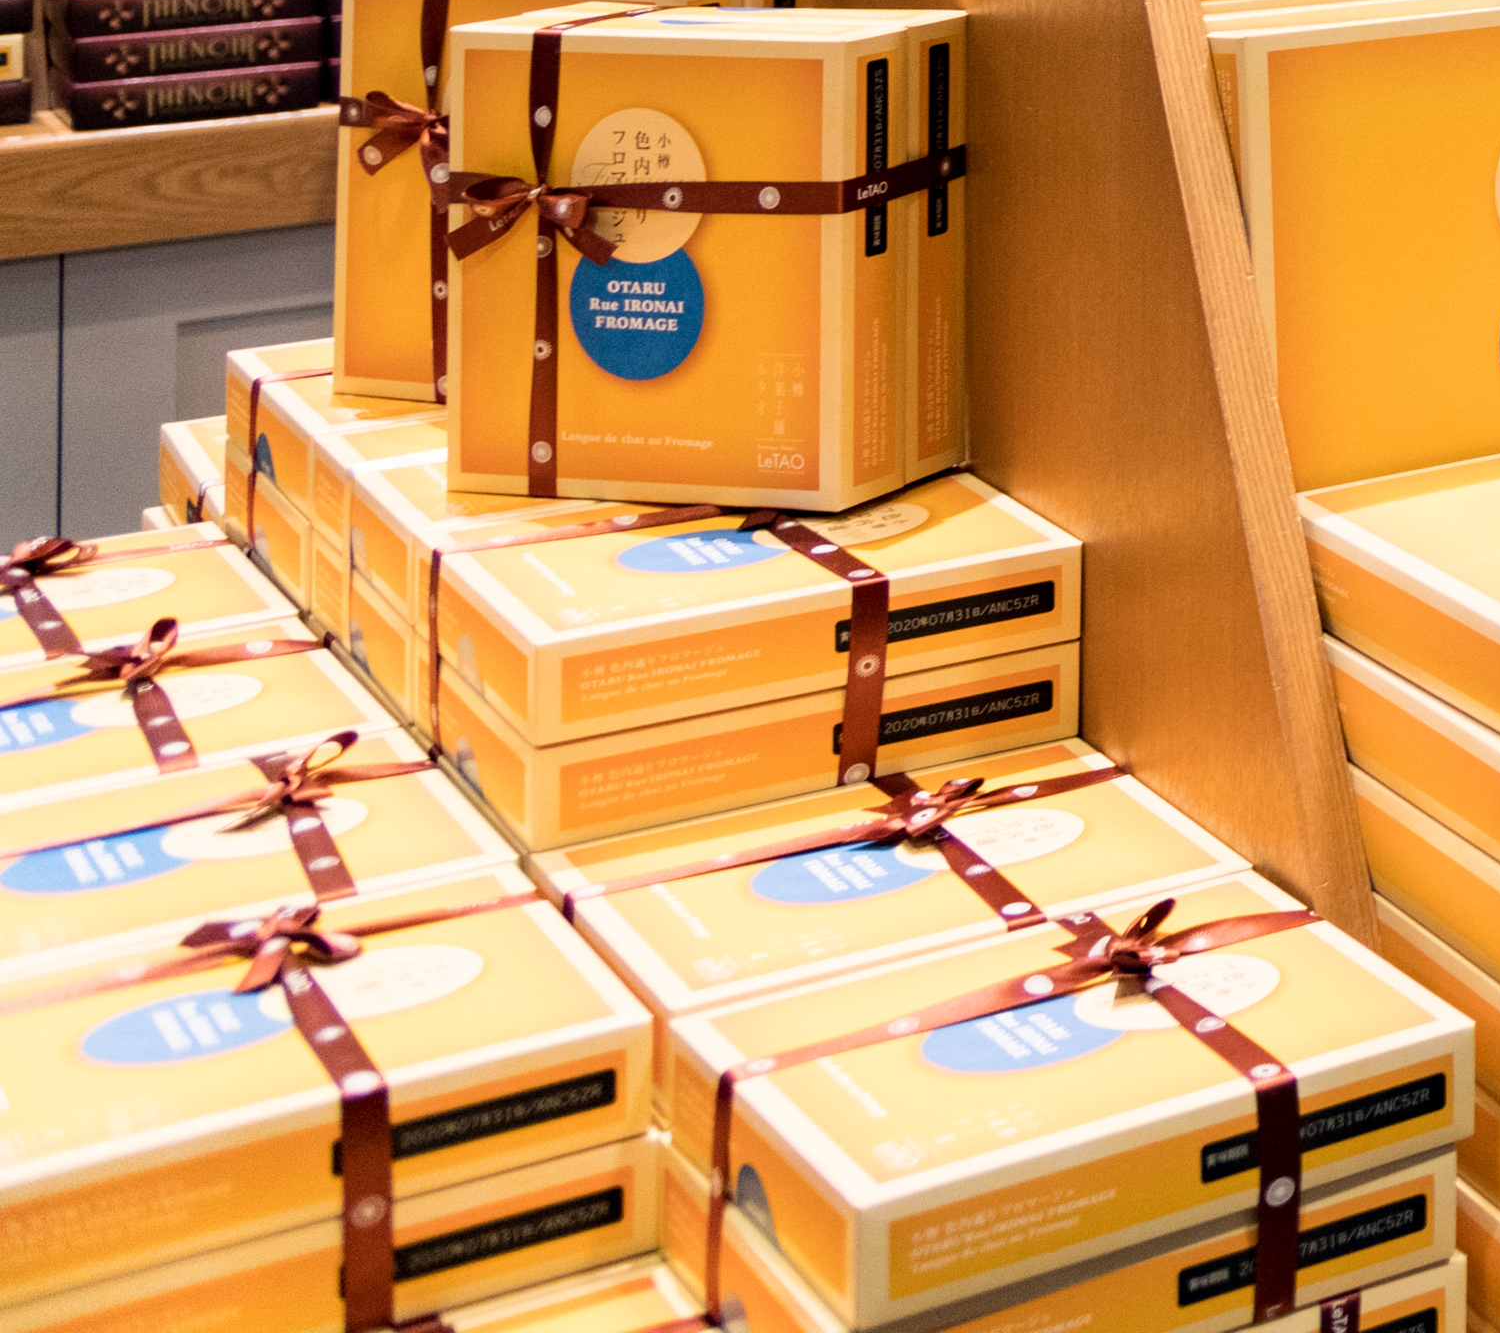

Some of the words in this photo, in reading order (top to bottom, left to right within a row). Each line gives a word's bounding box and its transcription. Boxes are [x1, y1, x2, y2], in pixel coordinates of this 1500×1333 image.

[857, 180, 889, 201] LeTAO
[606, 279, 666, 295] OTARU
[588, 297, 619, 312] Rue
[623, 299, 685, 315] IRONAI
[594, 315, 679, 332] FROMAGE
[757, 452, 805, 470] LeTAO
